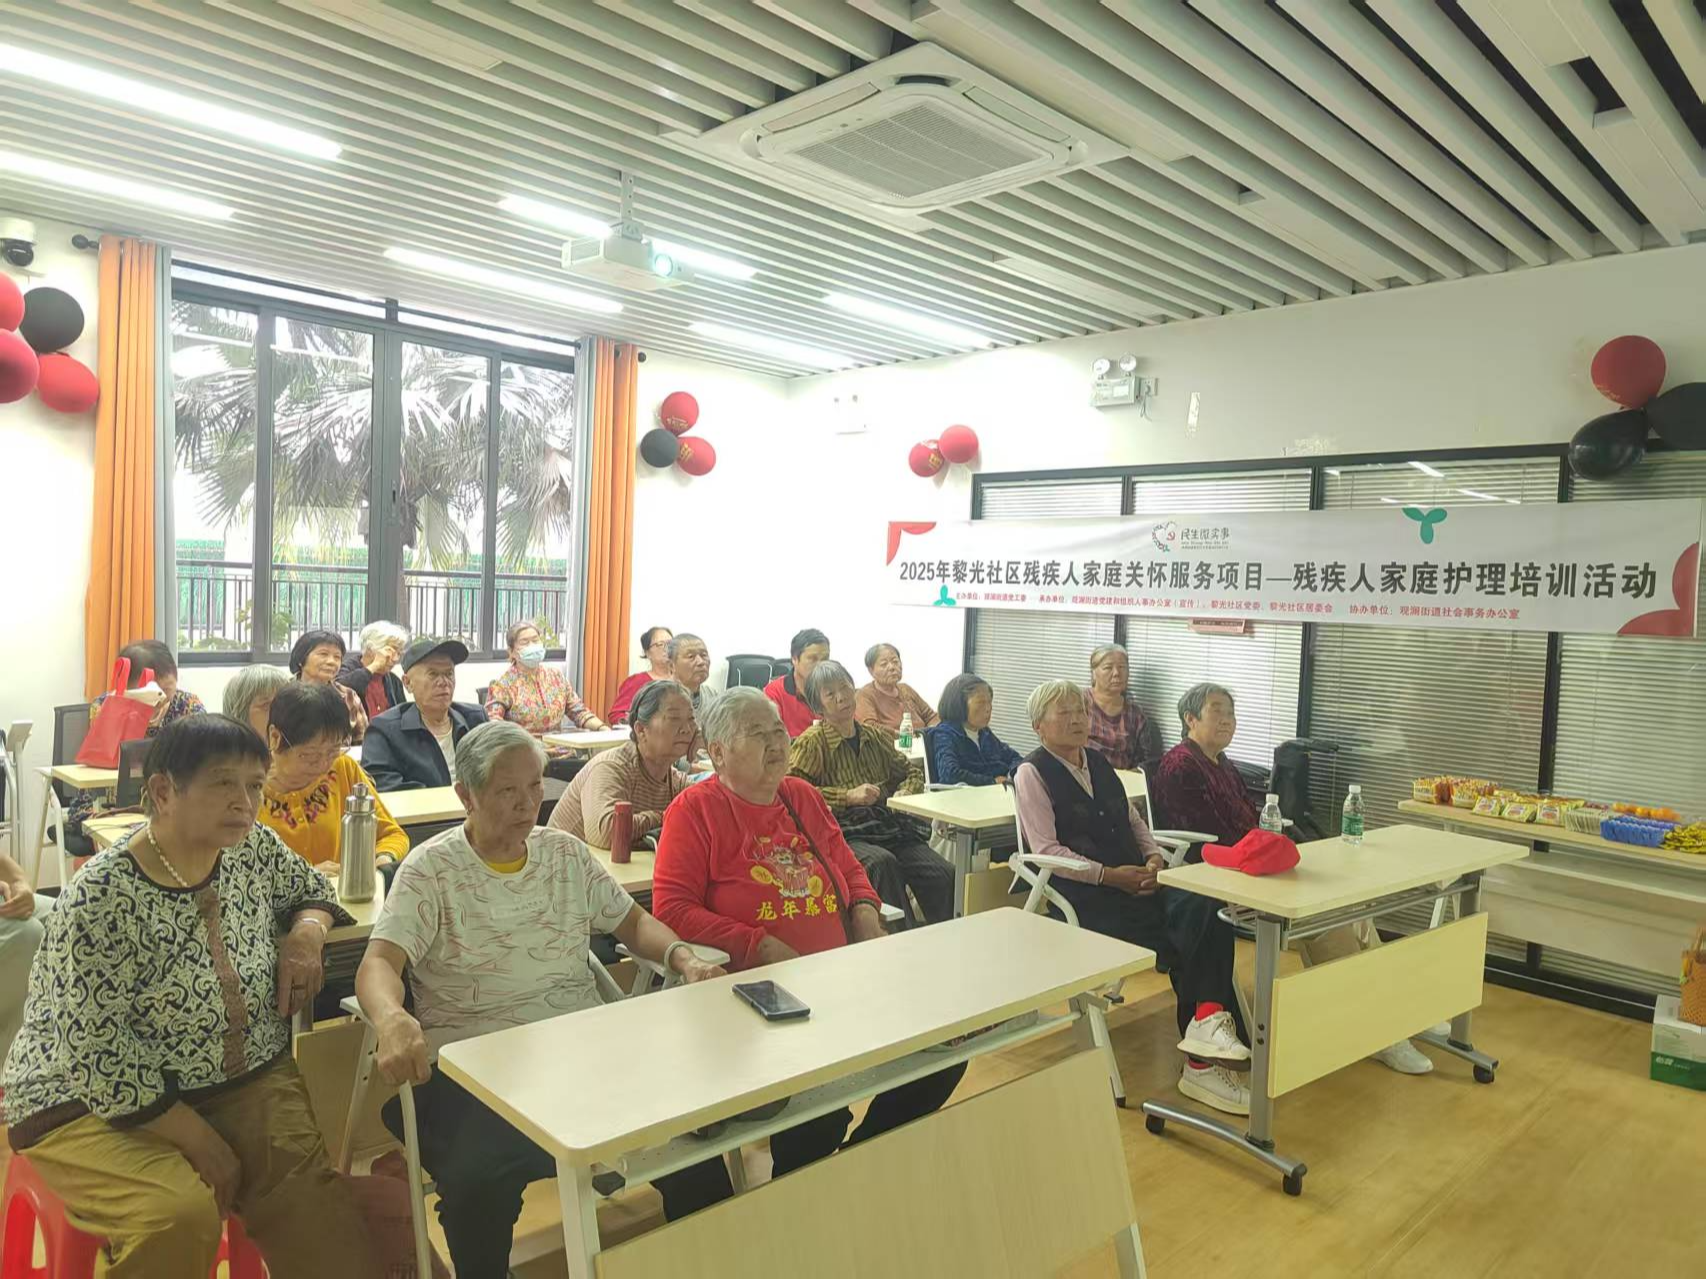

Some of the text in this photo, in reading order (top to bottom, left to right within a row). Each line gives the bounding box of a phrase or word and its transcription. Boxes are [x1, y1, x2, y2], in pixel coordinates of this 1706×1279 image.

[1181, 527, 1229, 540] 民生微实事
